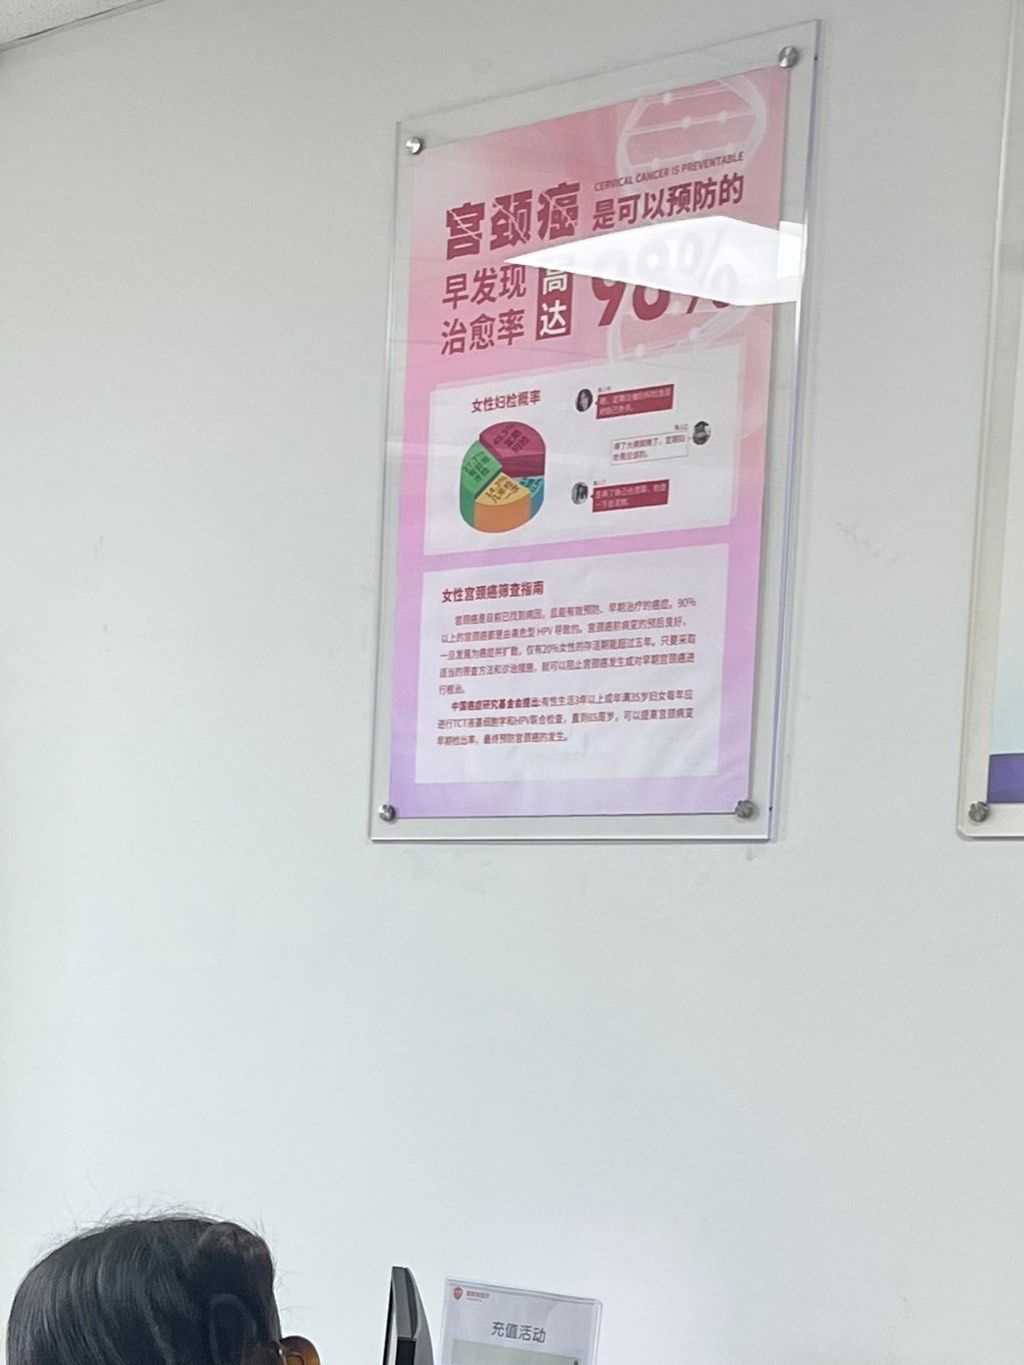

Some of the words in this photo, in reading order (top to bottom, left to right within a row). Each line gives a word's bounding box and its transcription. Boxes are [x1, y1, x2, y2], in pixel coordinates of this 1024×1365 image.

[593, 175, 633, 192] CERVICAL
[635, 167, 670, 184] CANCER
[672, 164, 680, 176] IS
[681, 150, 745, 174] PREVENTABLE
[446, 182, 581, 260] 宫颈癌
[592, 172, 745, 232] 是可以预防的
[442, 264, 526, 310] 早发现
[441, 309, 525, 355] 治愈率
[441, 580, 545, 603] 女性宫颈癌筛查指南
[491, 1321, 547, 1344] 充值活动
